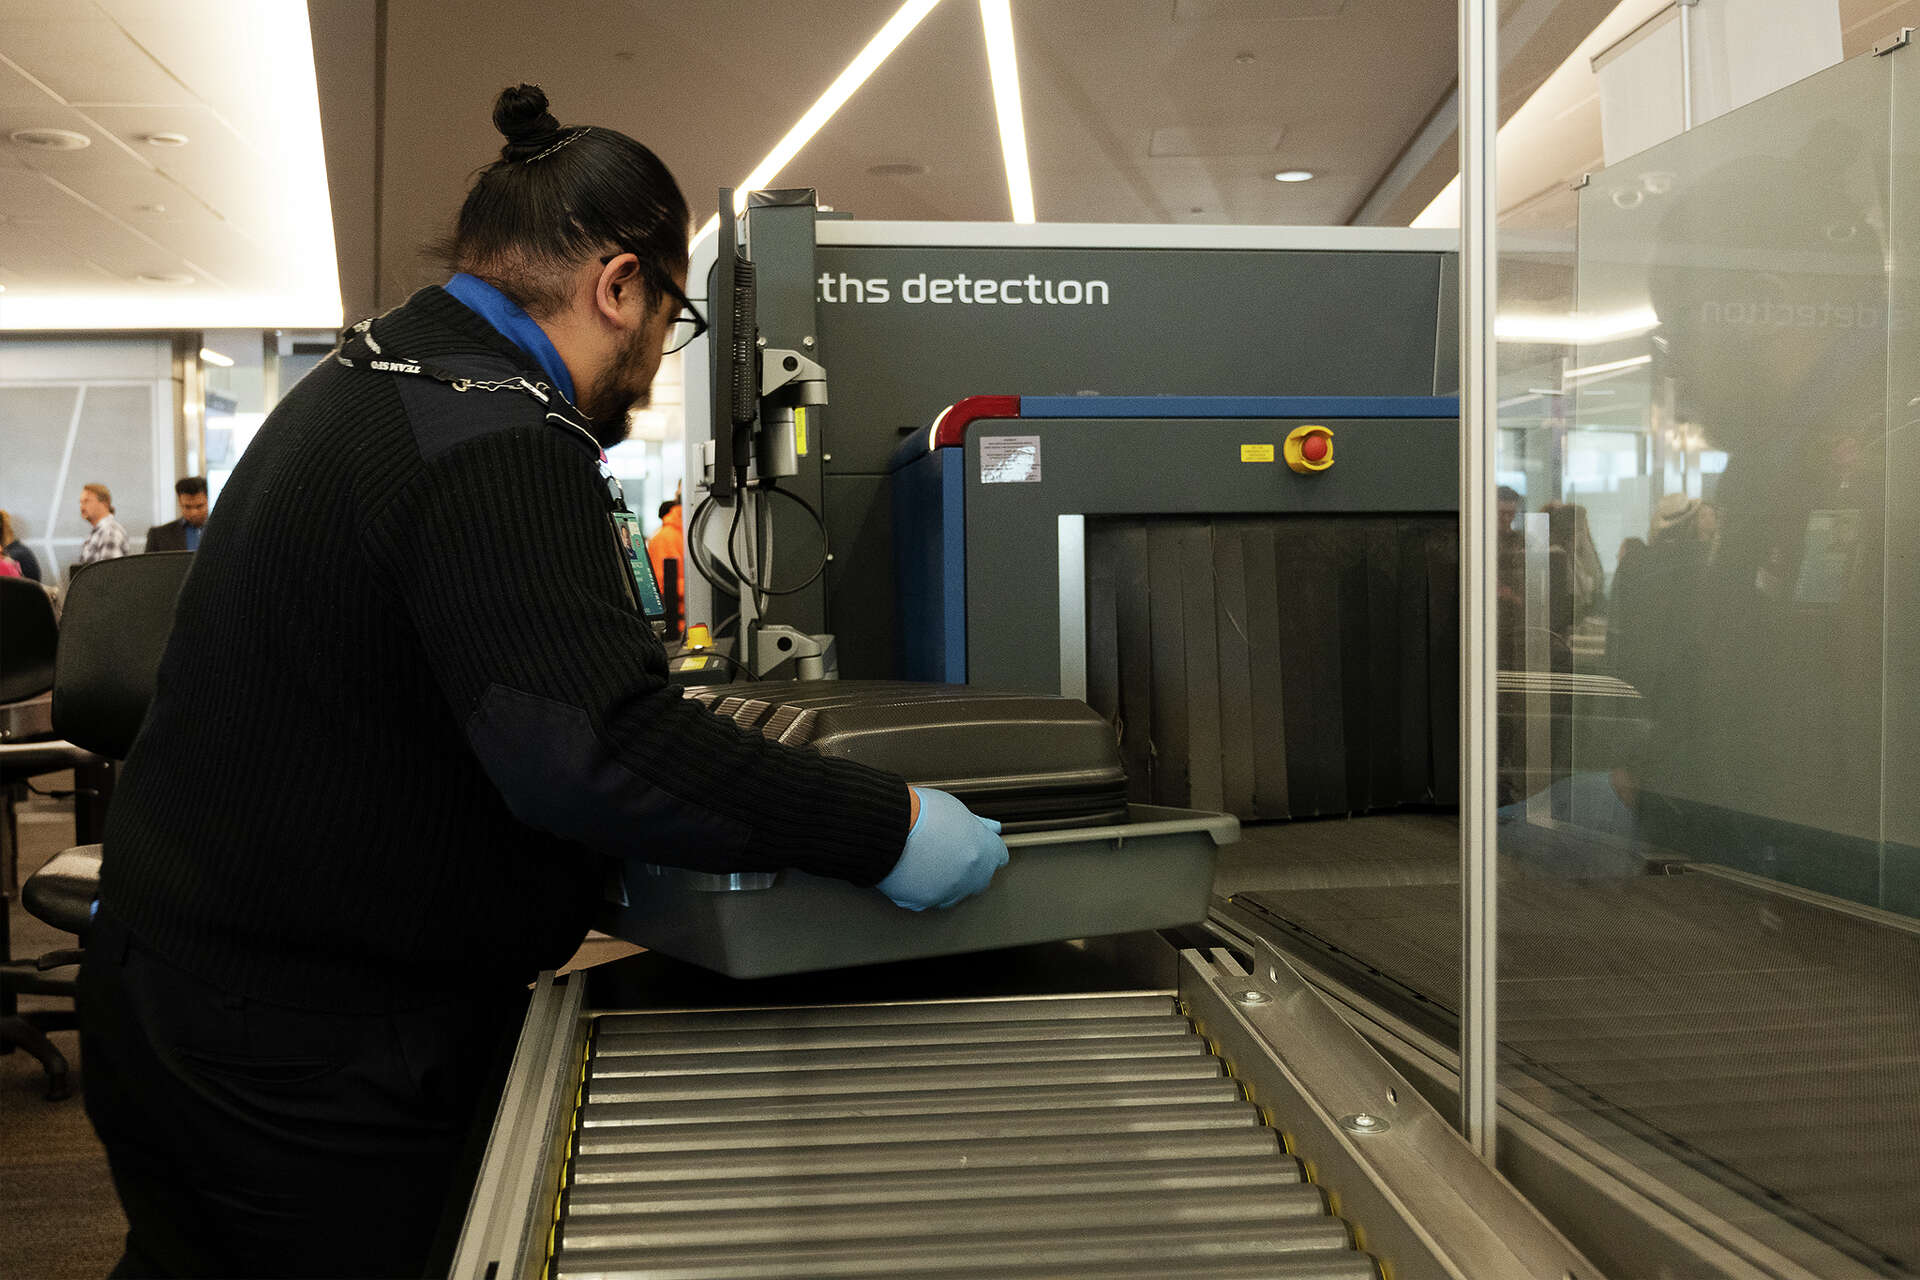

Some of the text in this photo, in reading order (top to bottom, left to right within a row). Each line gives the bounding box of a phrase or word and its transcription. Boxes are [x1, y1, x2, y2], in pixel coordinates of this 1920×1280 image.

[818, 273, 1109, 304] ths detection
[389, 362, 421, 374] TEAM
